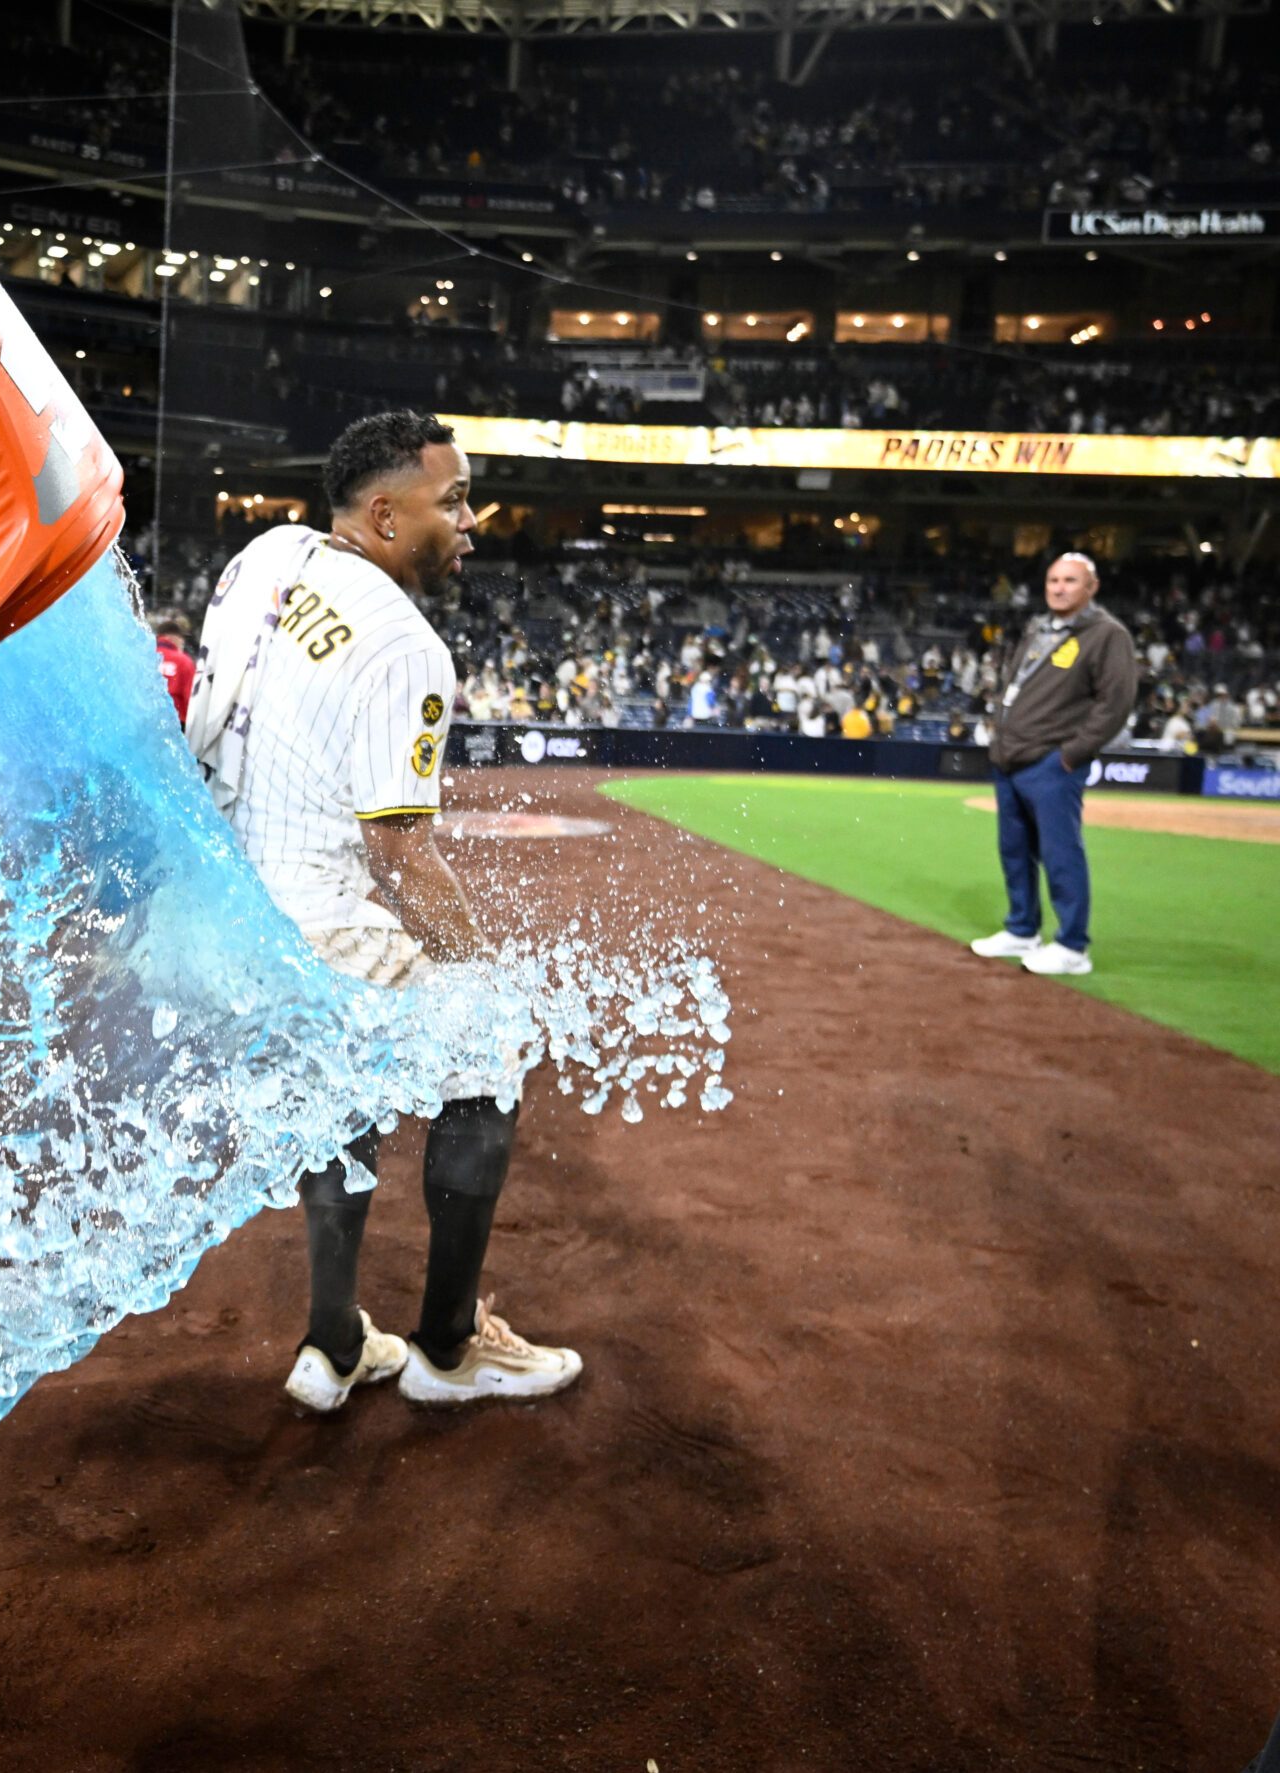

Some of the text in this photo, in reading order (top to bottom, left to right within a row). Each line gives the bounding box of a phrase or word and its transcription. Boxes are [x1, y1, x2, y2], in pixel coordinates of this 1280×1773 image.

[79, 143, 102, 161] 35
[10, 202, 122, 235] CENTER
[1070, 208, 1265, 239] UC San Diego Health
[879, 437, 1075, 467] PADRES WIN
[279, 580, 354, 664] ERTS
